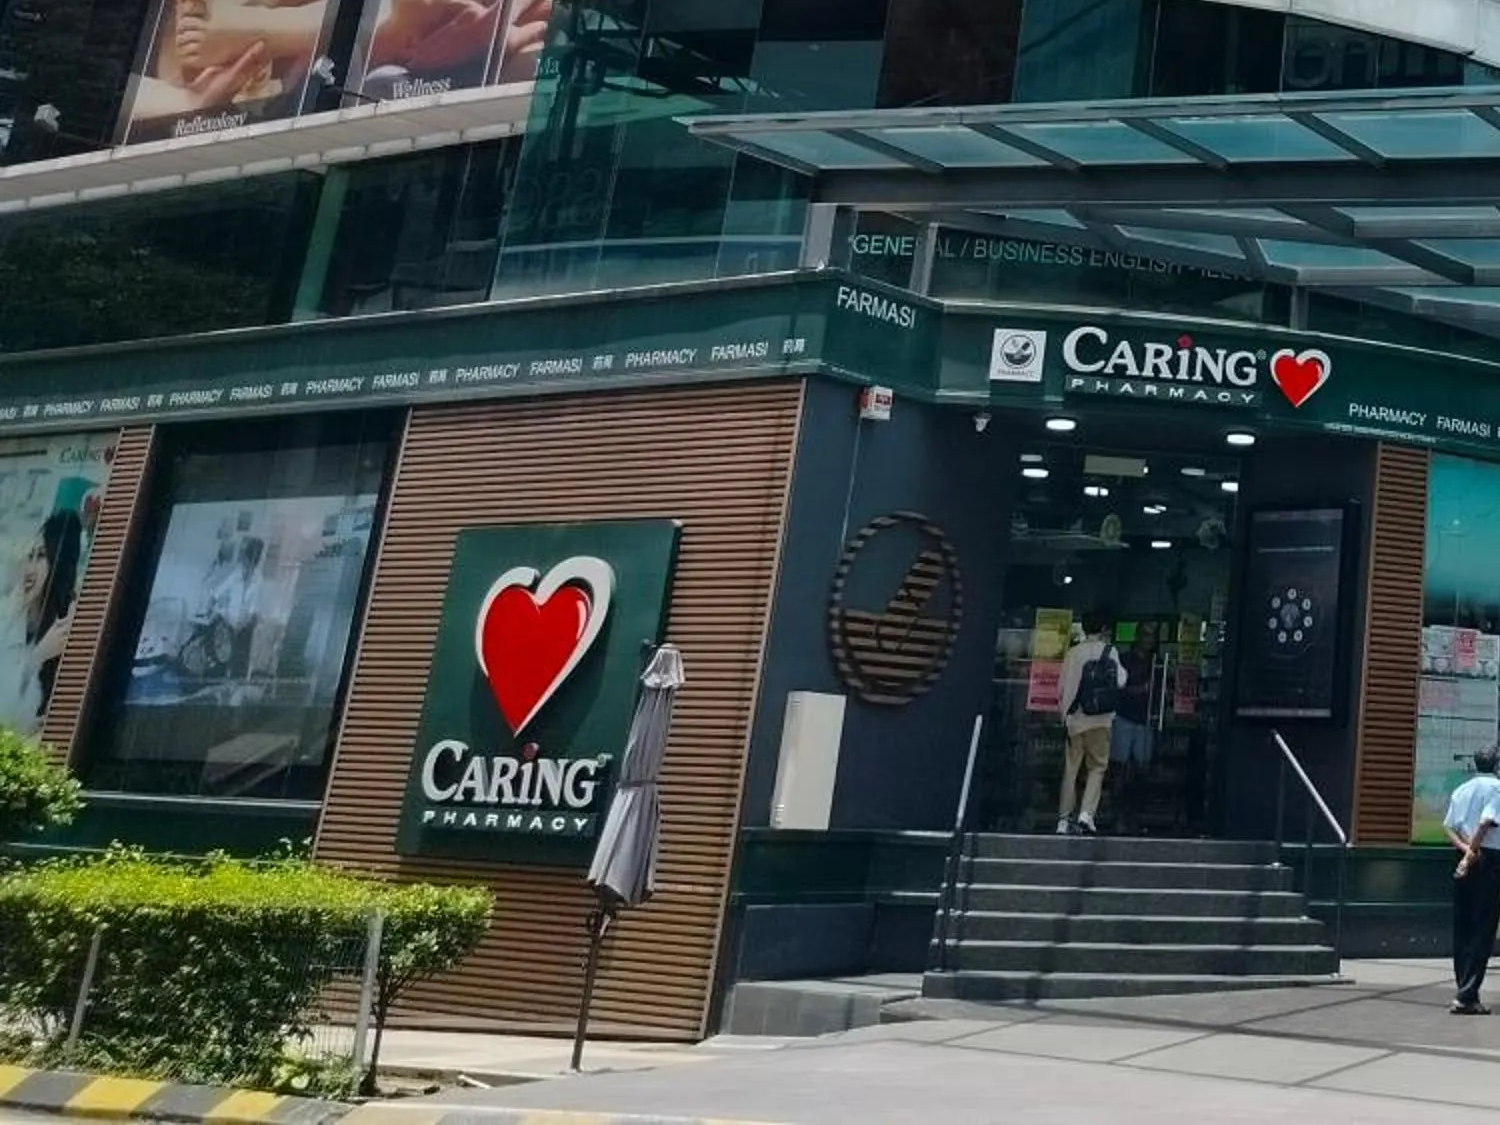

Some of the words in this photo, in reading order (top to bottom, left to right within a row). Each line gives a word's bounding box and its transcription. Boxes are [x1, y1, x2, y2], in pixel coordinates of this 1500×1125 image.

[973, 238, 1084, 265] BUSINESS
[837, 286, 917, 330] FARMASI
[305, 376, 364, 395] PHARMACY
[372, 371, 420, 390] FARMASI
[455, 362, 521, 384] PHARMACY
[529, 357, 583, 376] FARMASI
[625, 347, 699, 369] PHARMACY
[711, 342, 769, 361] FARMASI
[1071, 378, 1255, 404] PHARMACY
[1348, 402, 1428, 427] PHARMACY
[1436, 415, 1492, 438] FARMASI
[421, 810, 589, 832] PHARMACY
